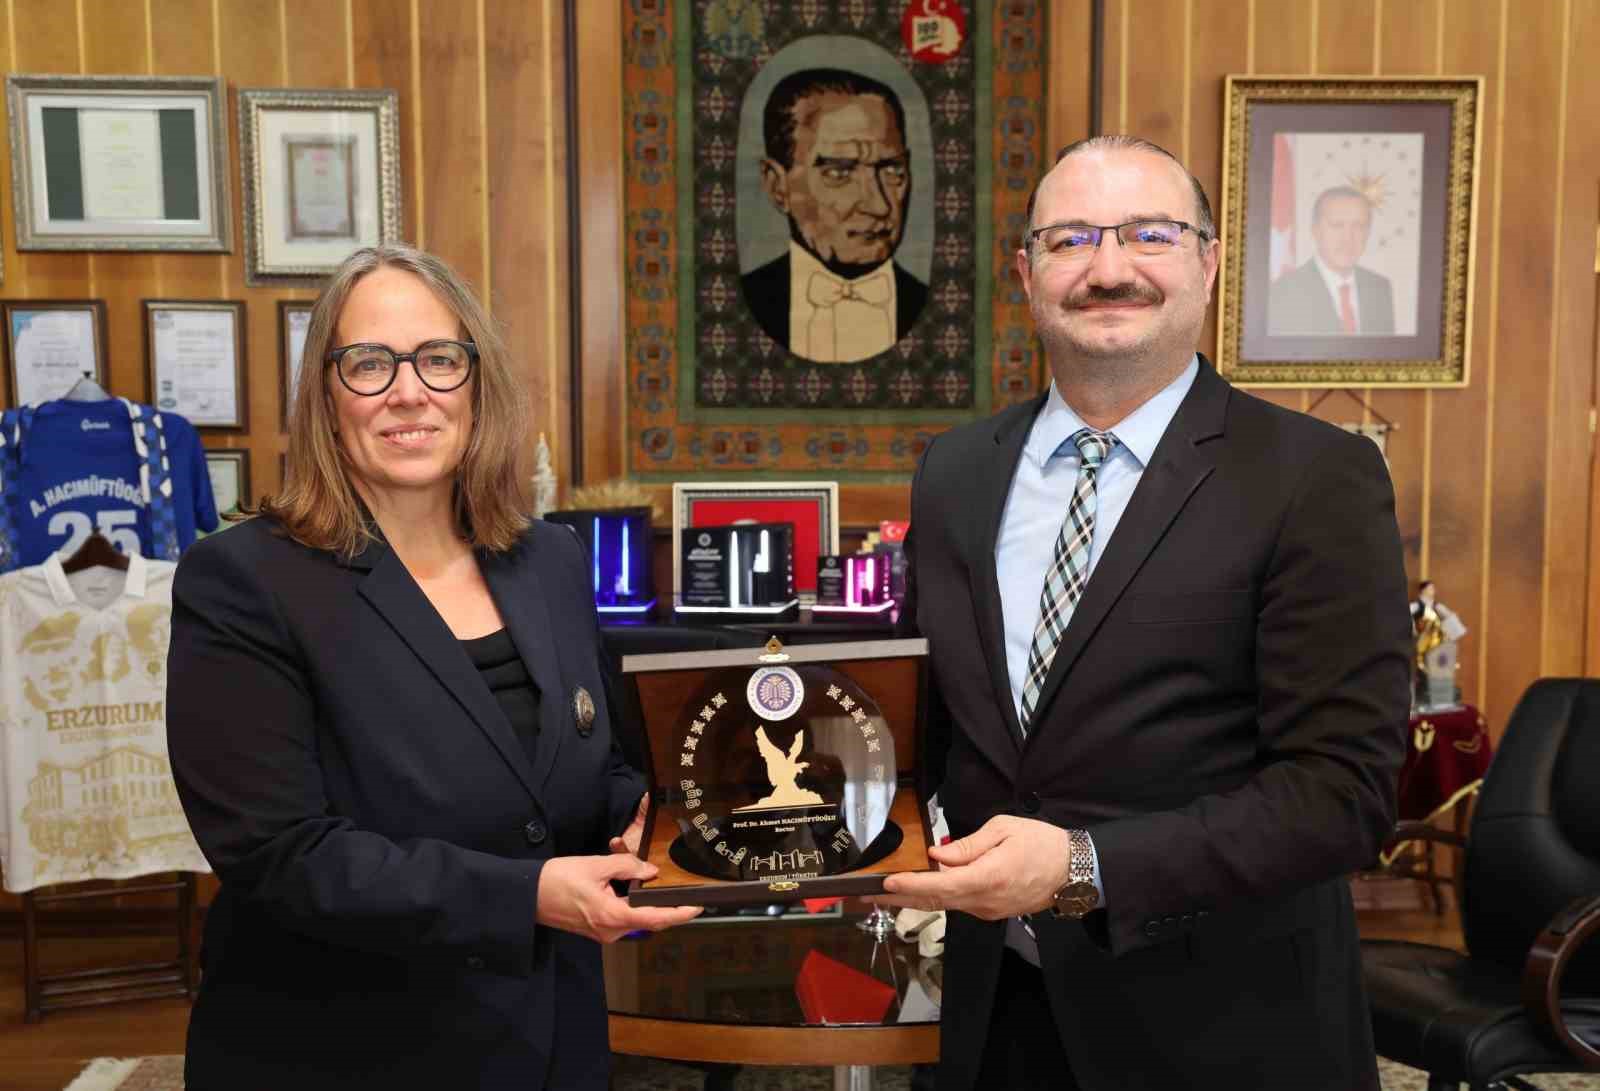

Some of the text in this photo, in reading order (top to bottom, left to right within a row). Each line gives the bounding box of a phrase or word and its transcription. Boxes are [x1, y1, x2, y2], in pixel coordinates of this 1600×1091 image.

[30, 499, 47, 519] A.
[47, 509, 141, 561] 25
[47, 701, 163, 731] ERZURUM
[732, 821, 748, 829] Prof.
[760, 818, 781, 827] Ahmet
